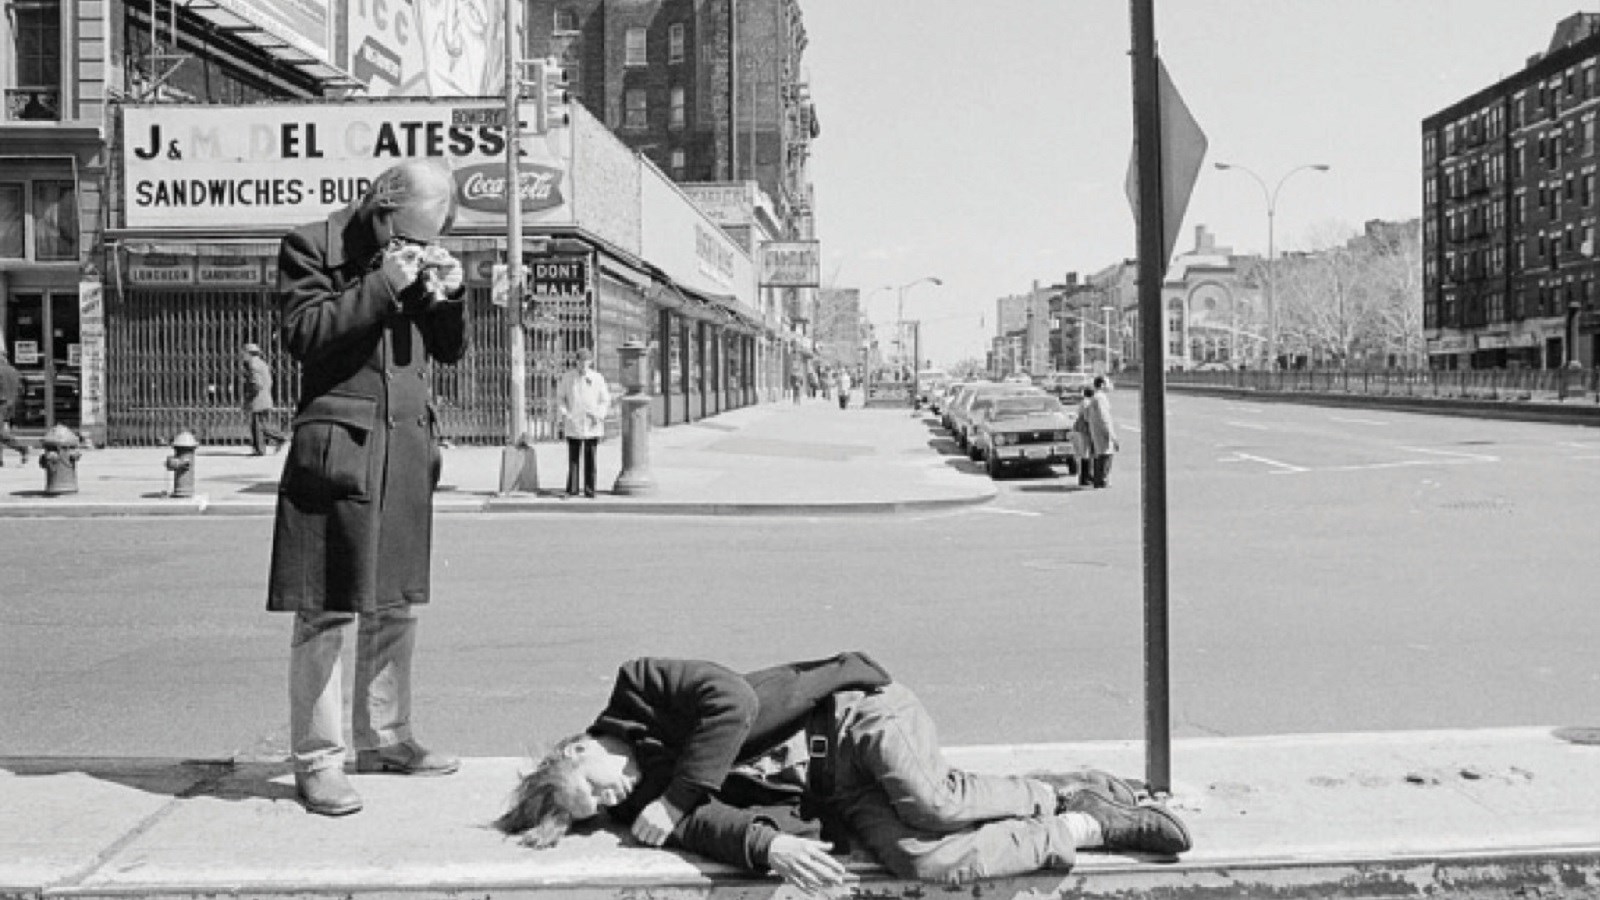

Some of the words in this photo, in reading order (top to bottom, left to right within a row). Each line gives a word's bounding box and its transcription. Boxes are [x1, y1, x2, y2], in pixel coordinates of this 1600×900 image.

[135, 123, 162, 160] J
[167, 141, 183, 161] &
[136, 178, 302, 208] SANDWICHES
[135, 268, 189, 281] LUNCHEON
[200, 268, 257, 281] SANDWICHES
[536, 264, 580, 279] DONT
